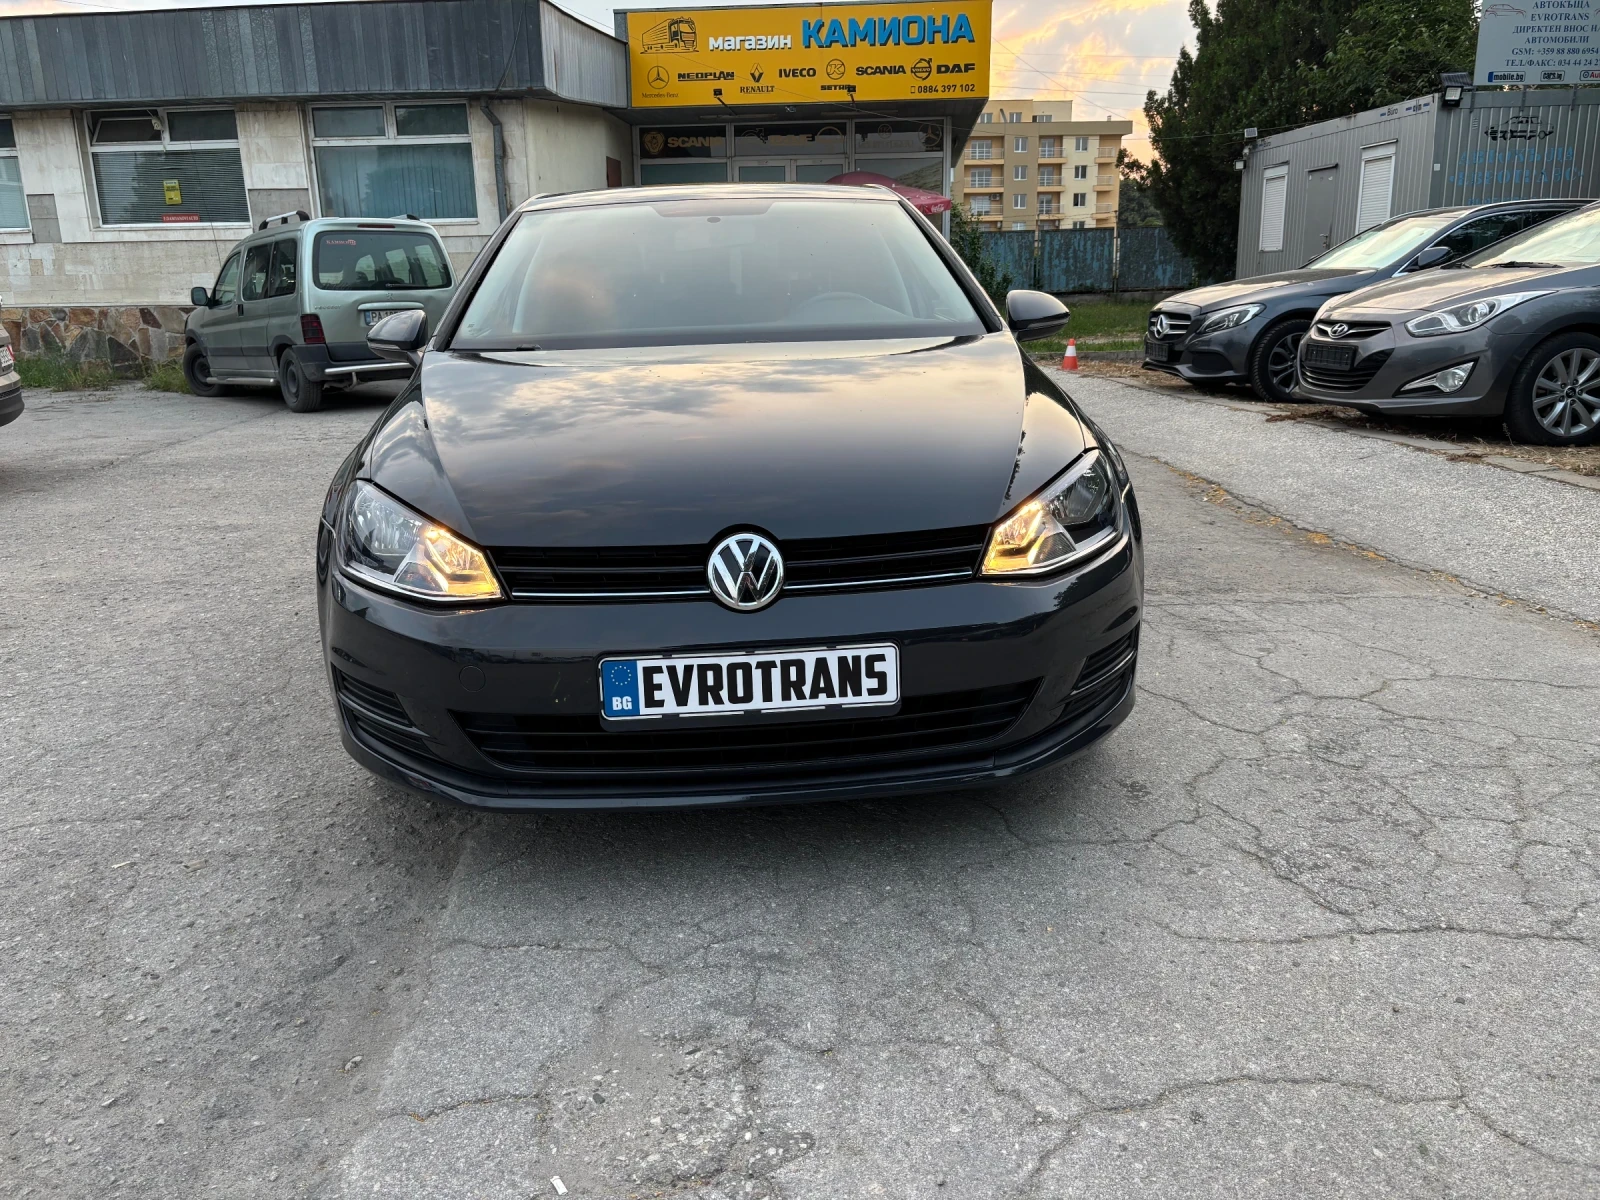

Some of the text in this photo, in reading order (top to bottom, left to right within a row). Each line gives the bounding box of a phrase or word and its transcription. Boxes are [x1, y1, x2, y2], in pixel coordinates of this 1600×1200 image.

[1532, 1, 1590, 9] АВТОКЪЩА
[1531, 13, 1589, 21] EVROTRANS
[708, 14, 974, 51] магазин КАМИОНА
[1512, 25, 1561, 33] ДИРЕКТЕН
[1525, 36, 1589, 44] АВТОМОБИЛИ
[678, 71, 734, 81] NEOPLAN
[778, 68, 816, 78] IVECO
[856, 65, 906, 76] SCANIA
[936, 63, 976, 74] DAF
[1493, 72, 1524, 81] mobile.bg
[740, 86, 775, 94] RENAULT
[917, 84, 976, 94] 0884 397 102
[641, 653, 888, 709] EVROTRANS
[611, 696, 632, 711] BG
